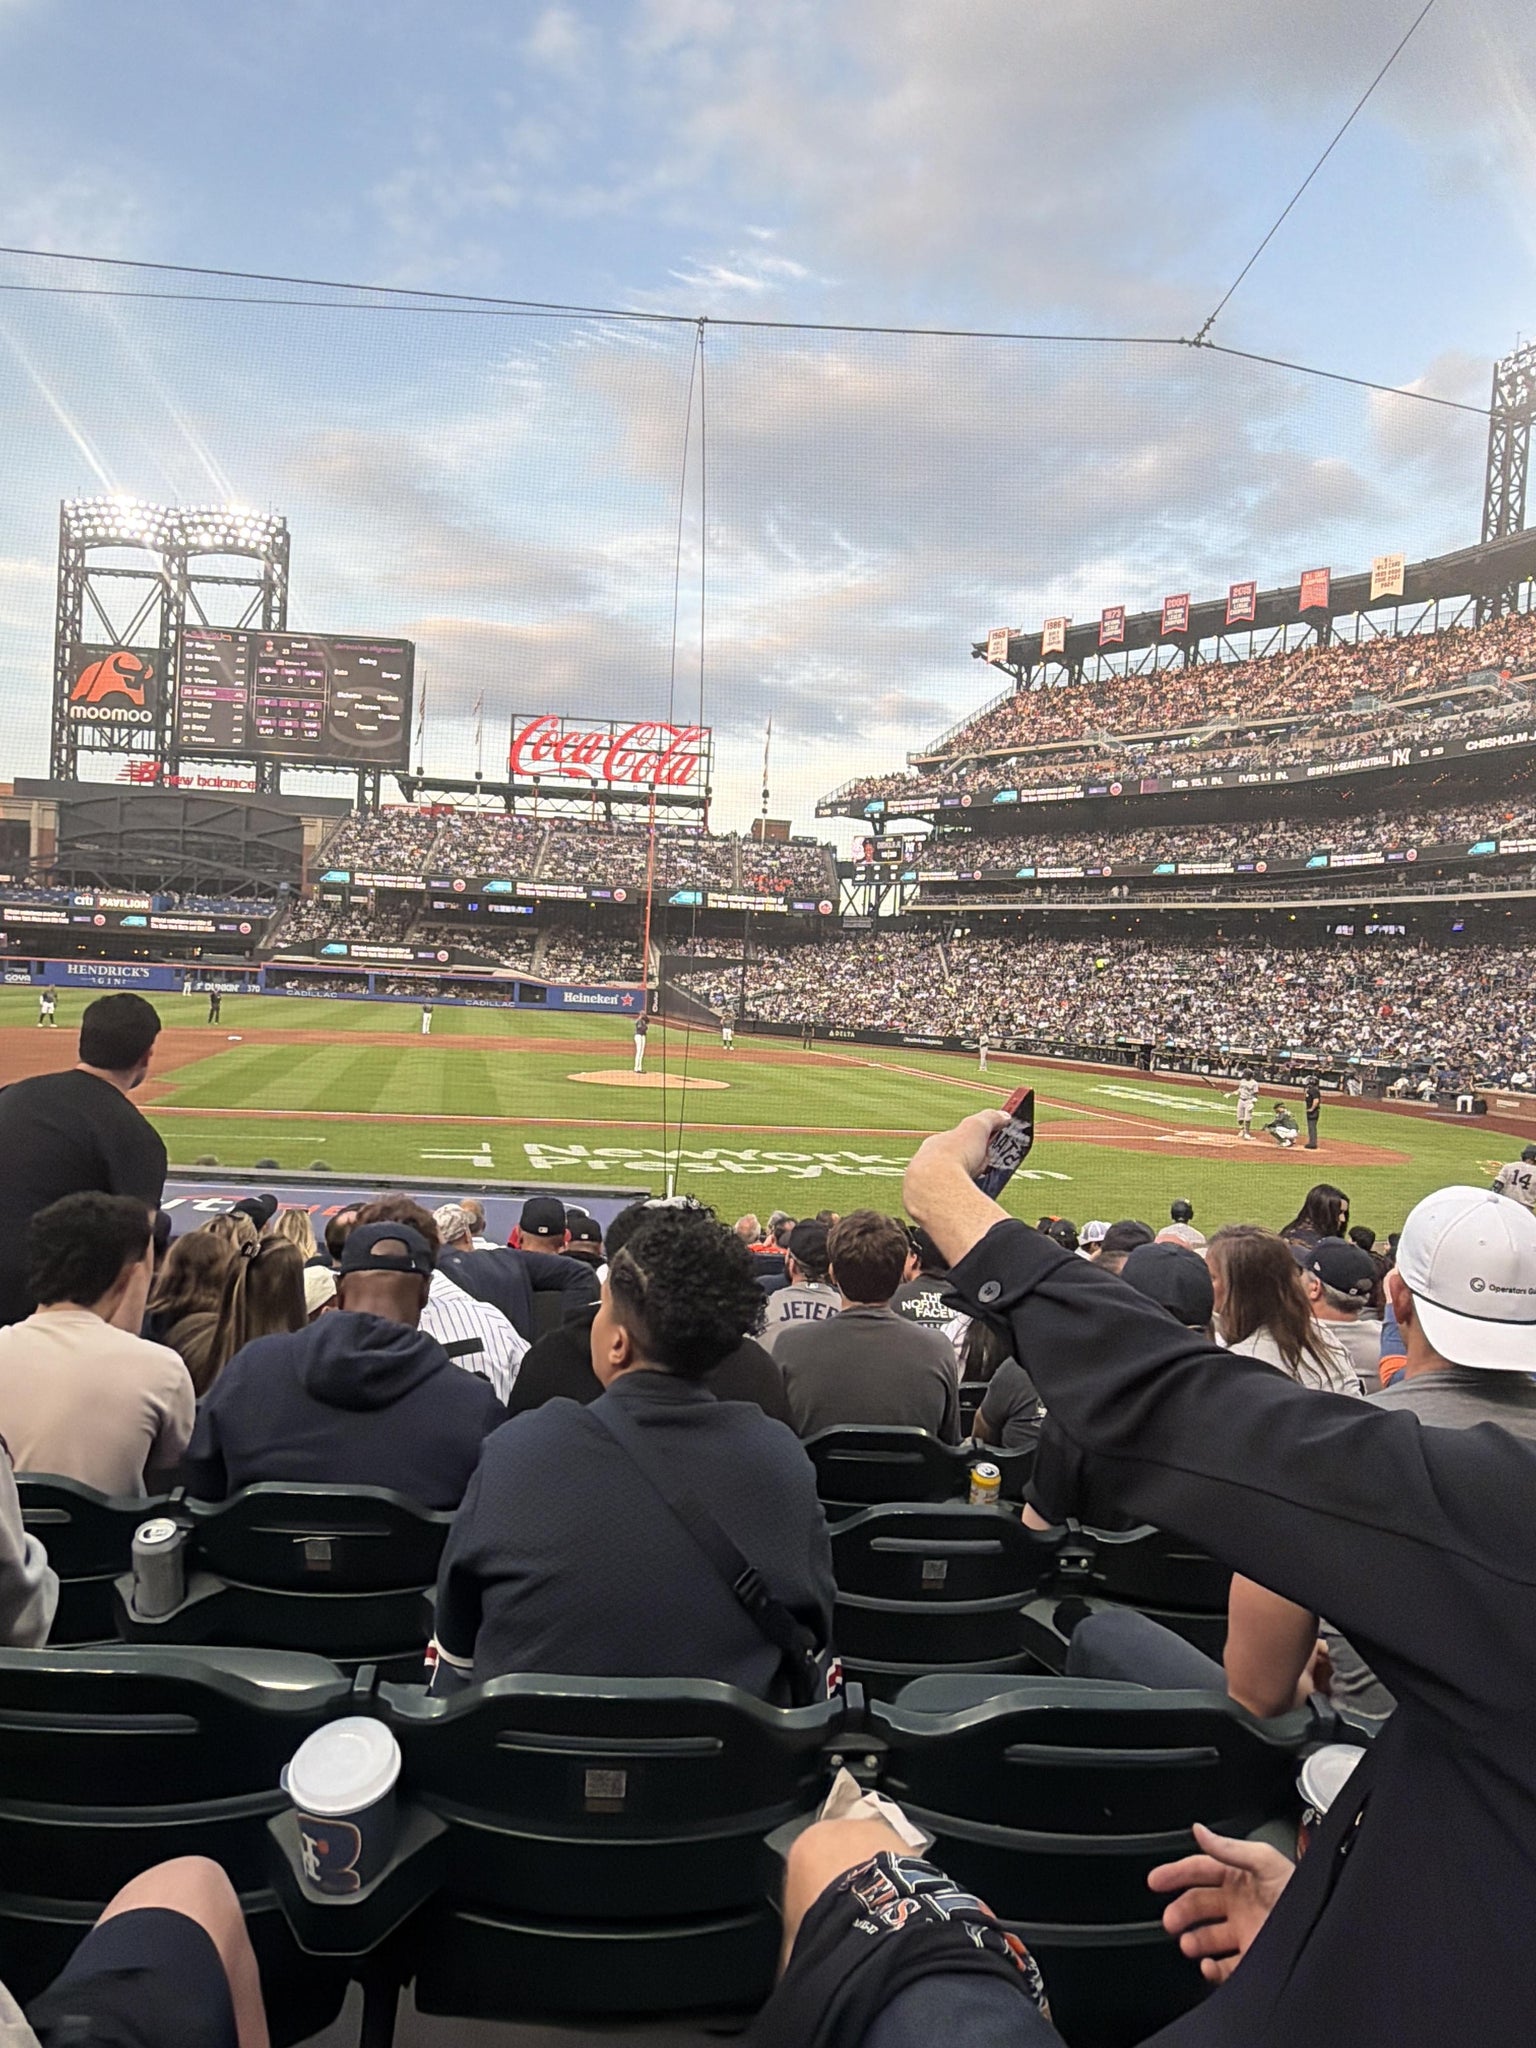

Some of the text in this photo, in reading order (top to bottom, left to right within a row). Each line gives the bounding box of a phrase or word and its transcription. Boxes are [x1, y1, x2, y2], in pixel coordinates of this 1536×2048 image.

[1047, 620, 1061, 630] 1986
[70, 706, 152, 723] moomoo
[1465, 732, 1528, 751] CHISHOLM
[510, 714, 712, 785] Coca-Cola
[1358, 755, 1390, 769] FASTBALL
[163, 774, 257, 790] new balance
[99, 898, 149, 909] PAVILION
[67, 963, 150, 978] HENDRICK'S
[4, 973, 32, 984] GOYA
[98, 976, 121, 986] GIN
[204, 982, 239, 993] DUNKIN'
[247, 985, 260, 993] 370
[286, 990, 338, 998] CADILLAC
[563, 991, 618, 1005] Heineken
[465, 1000, 516, 1008] CADILLAC
[1513, 1169, 1532, 1190] 14
[1489, 1284, 1527, 1294] Operators
[920, 1291, 943, 1302] THE
[915, 1307, 949, 1319] FACE
